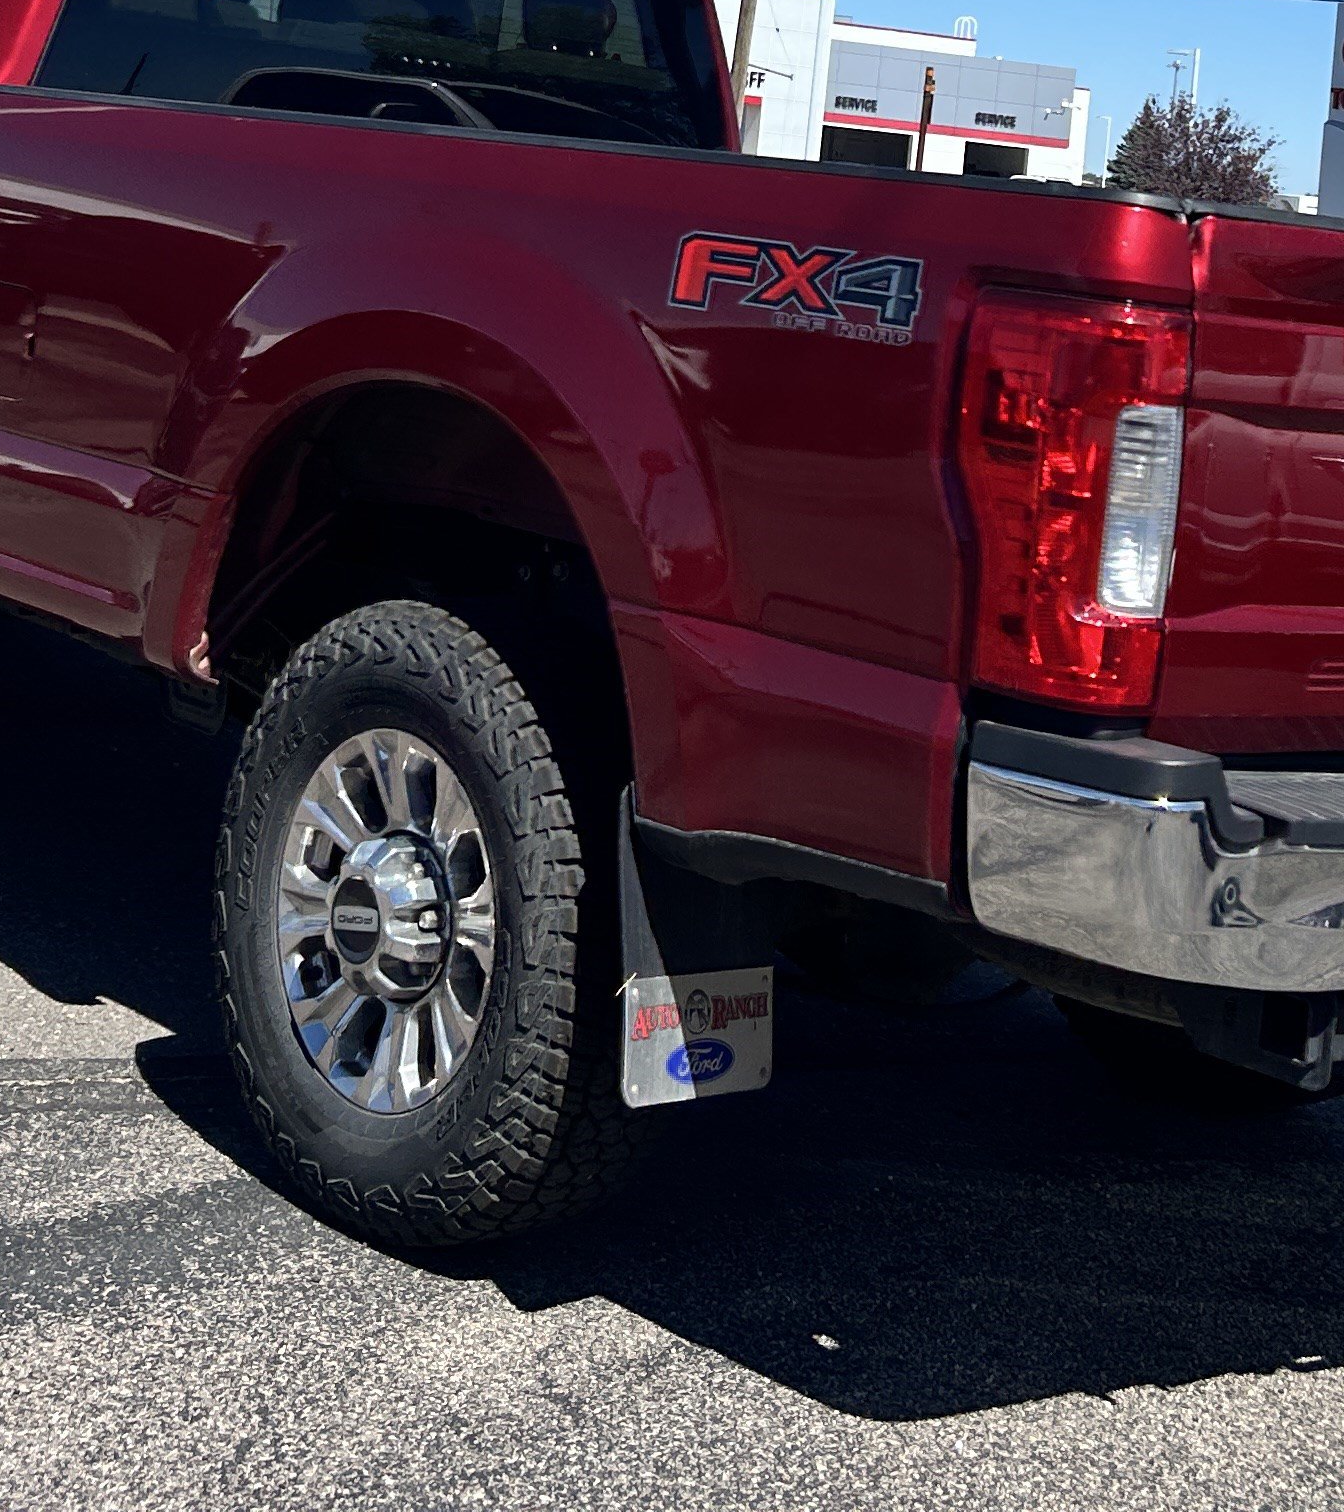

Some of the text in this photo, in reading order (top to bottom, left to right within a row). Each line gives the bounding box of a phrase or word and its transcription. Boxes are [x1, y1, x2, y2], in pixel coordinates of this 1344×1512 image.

[745, 71, 766, 88] FF
[834, 95, 878, 114] SERVICE
[974, 111, 1017, 130] SERVICE
[667, 230, 925, 331] FX4
[773, 311, 913, 346] OFF ROAD
[630, 991, 770, 1042] AUTO RANCH
[676, 1046, 724, 1078] Ford
